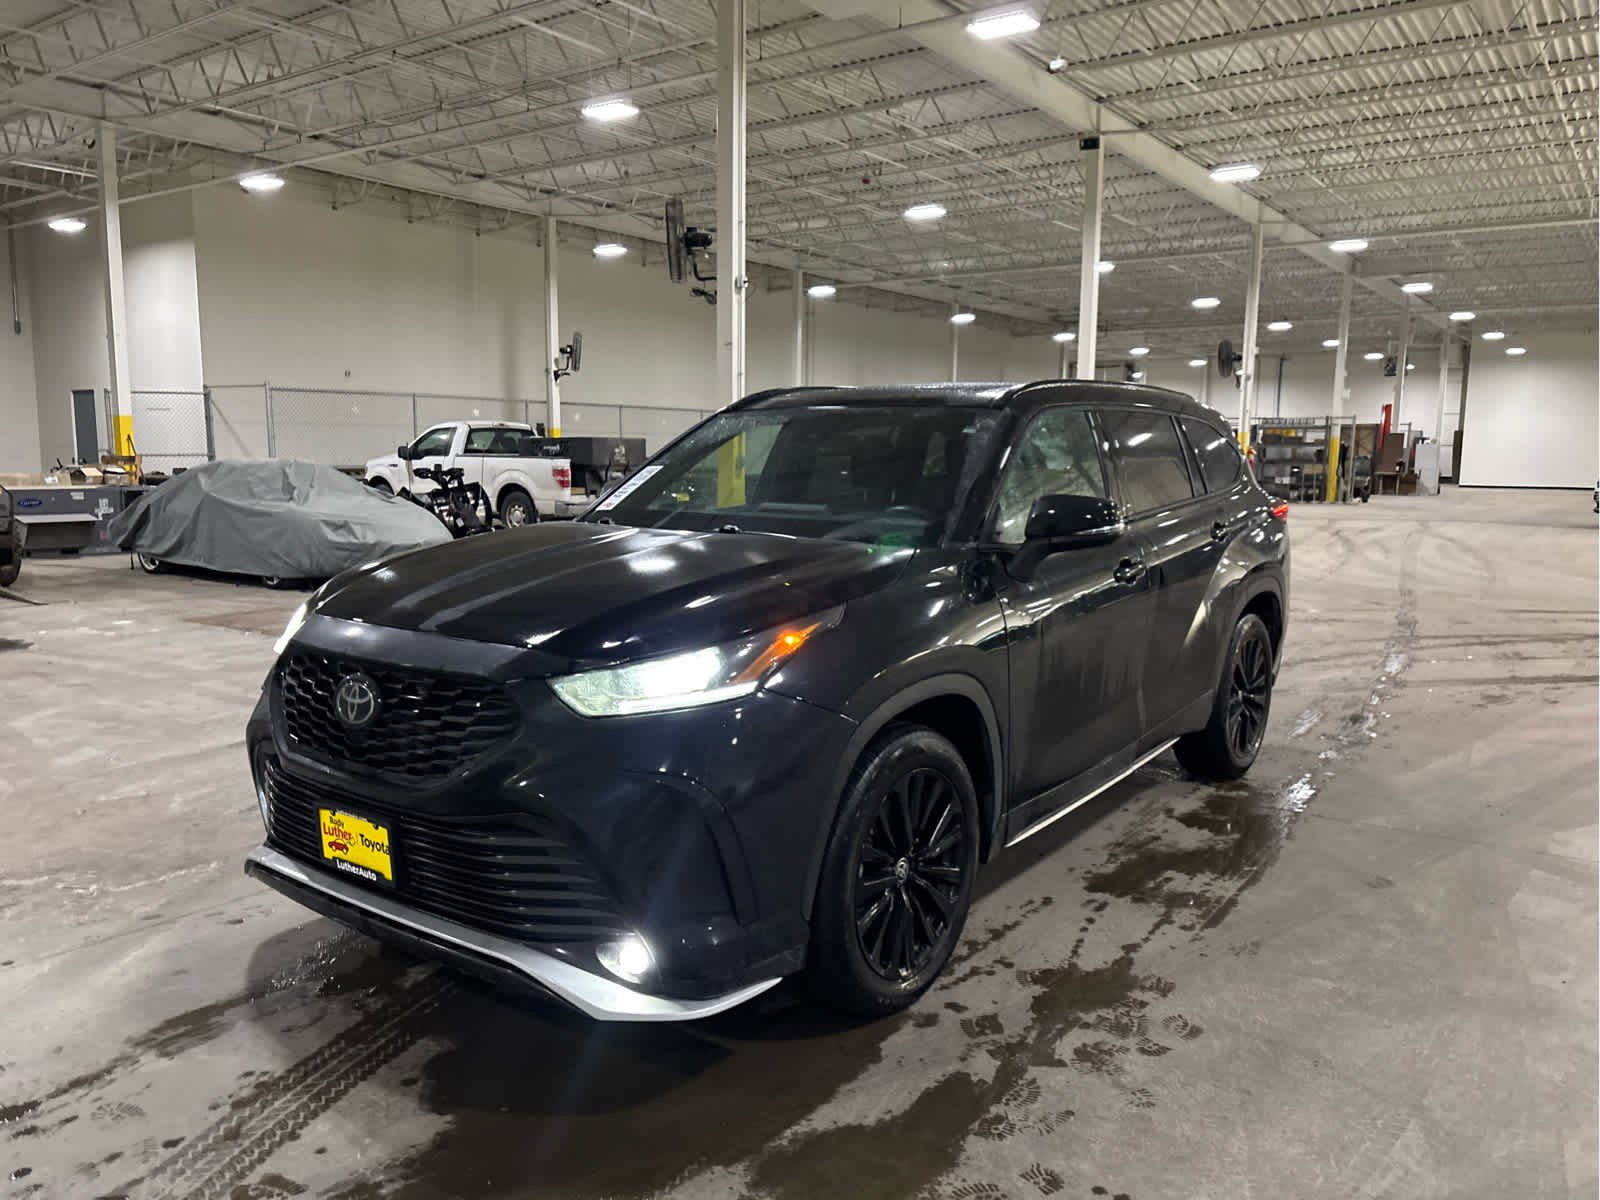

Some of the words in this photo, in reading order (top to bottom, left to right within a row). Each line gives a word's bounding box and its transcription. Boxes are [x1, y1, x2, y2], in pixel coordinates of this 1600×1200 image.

[323, 821, 352, 841] Luther
[359, 833, 390, 856] Toyota
[336, 858, 377, 881] LutherAuto
